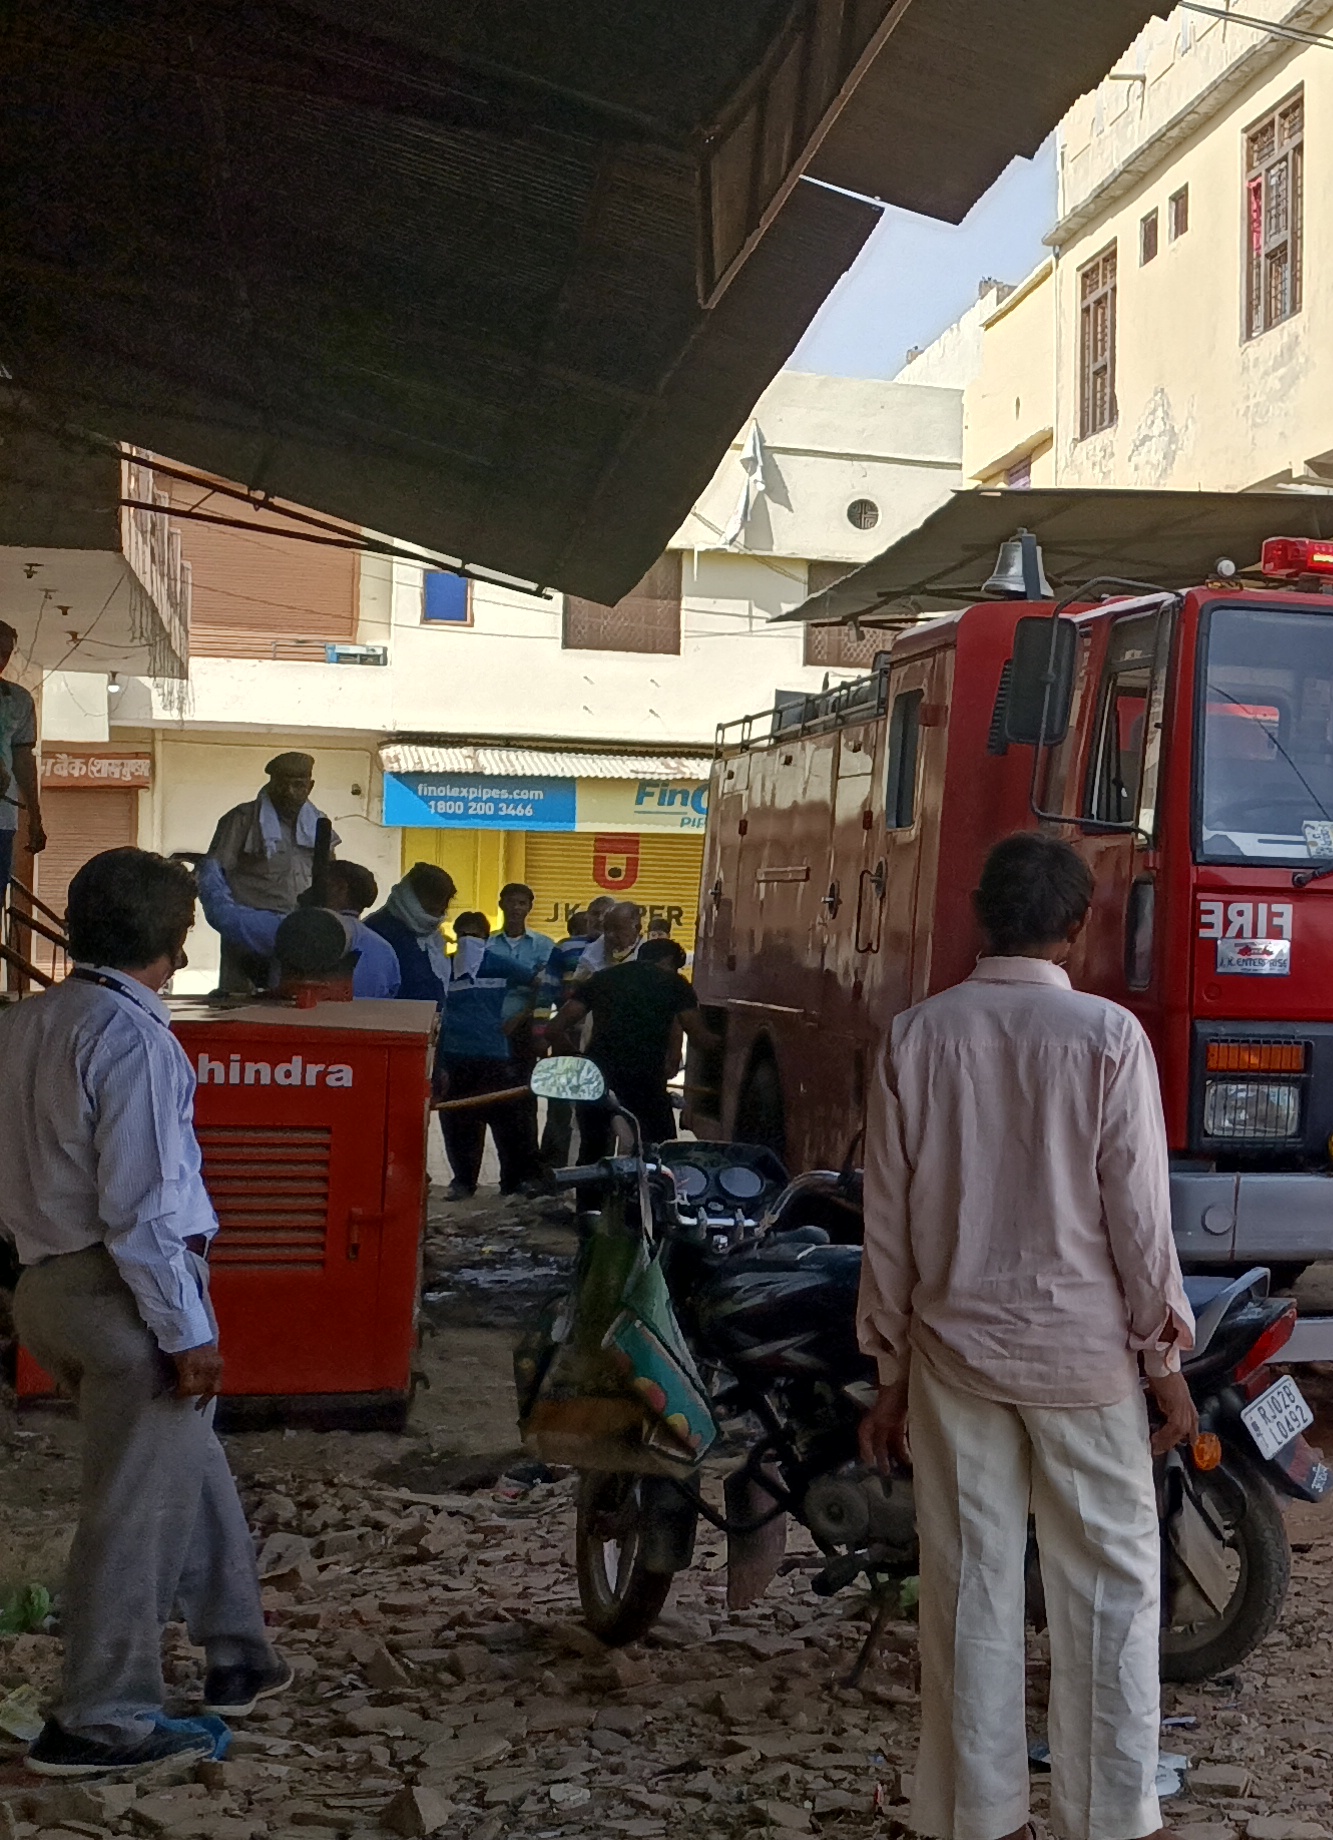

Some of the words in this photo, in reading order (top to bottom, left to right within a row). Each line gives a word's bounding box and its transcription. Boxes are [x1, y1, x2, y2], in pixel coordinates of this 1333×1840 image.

[428, 800, 464, 814] 1800
[468, 801, 494, 815] 200
[498, 802, 534, 817] 3466
[197, 1054, 353, 1088] hindra
